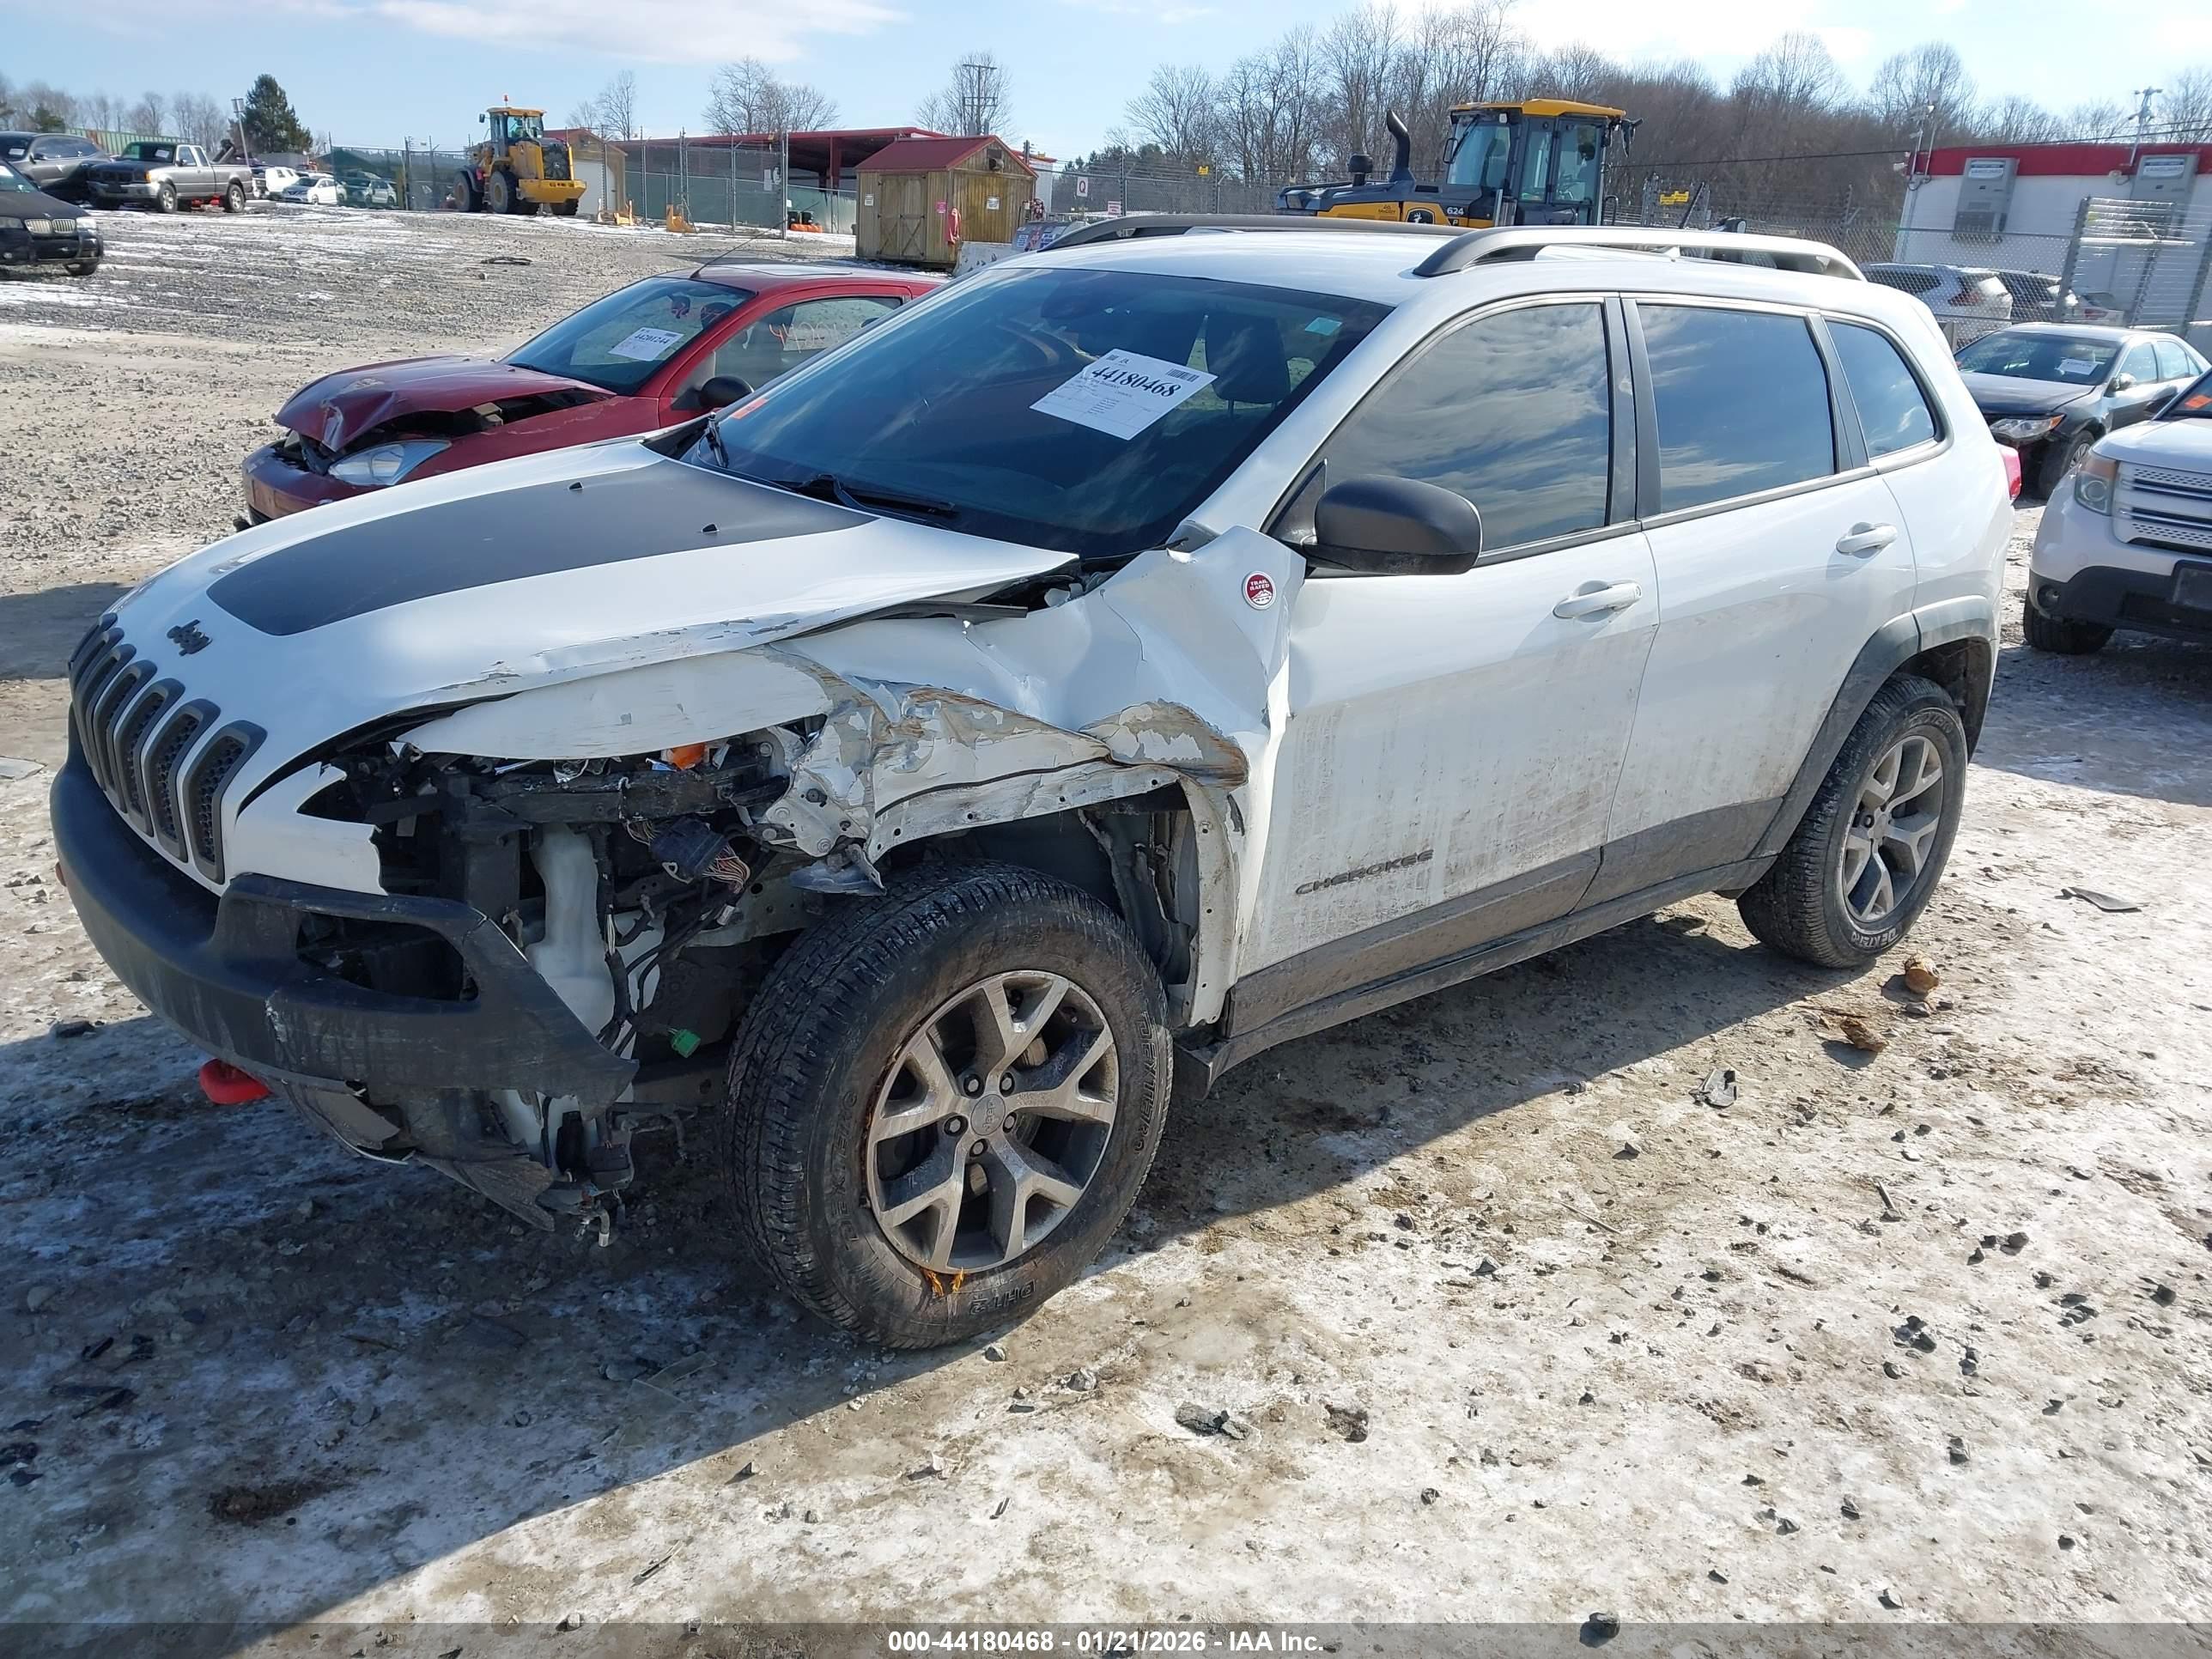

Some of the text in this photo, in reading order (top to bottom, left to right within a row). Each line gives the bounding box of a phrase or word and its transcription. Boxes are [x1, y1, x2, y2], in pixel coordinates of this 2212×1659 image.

[1079, 180, 1086, 193] Q
[1446, 207, 1464, 216] 624
[1091, 366, 1182, 398] 44180468
[1249, 583, 1270, 592] RATED
[1295, 848, 1434, 895] CHEROKEE
